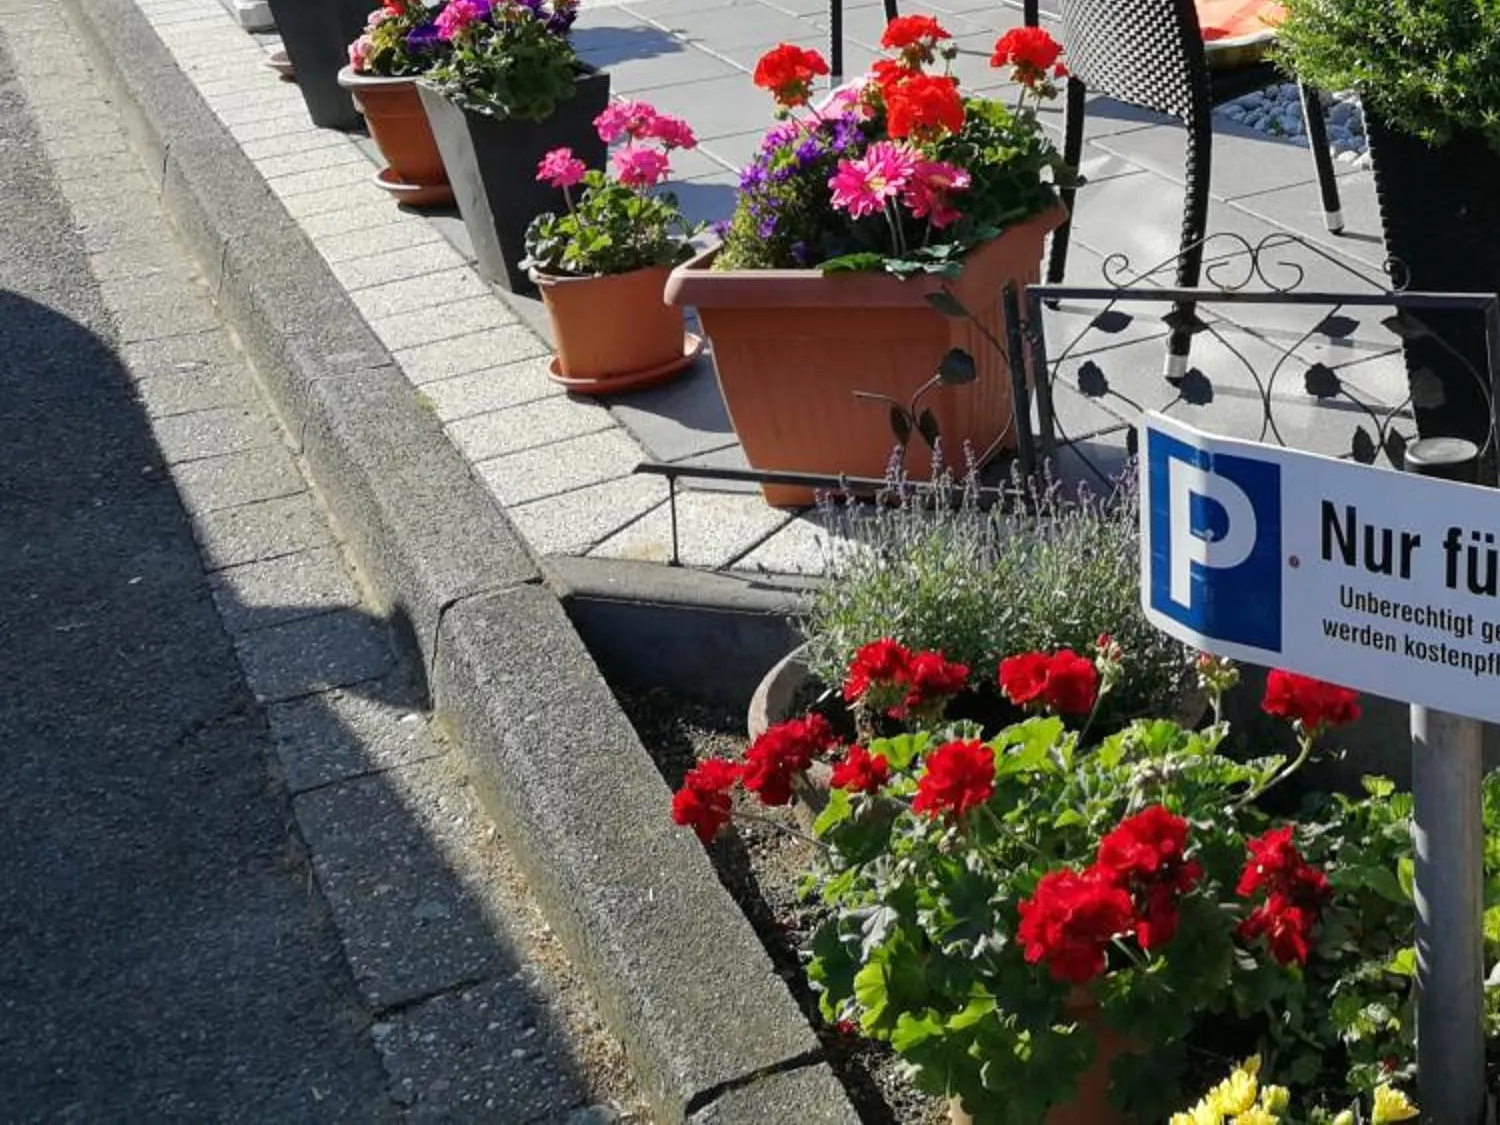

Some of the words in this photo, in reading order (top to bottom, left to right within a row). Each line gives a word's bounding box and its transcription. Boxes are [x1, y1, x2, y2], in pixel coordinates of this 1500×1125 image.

[1168, 455, 1257, 610] P
[1321, 499, 1421, 579] Nur
[1322, 618, 1396, 652] werden
[1340, 584, 1474, 638] Unberechtigt
